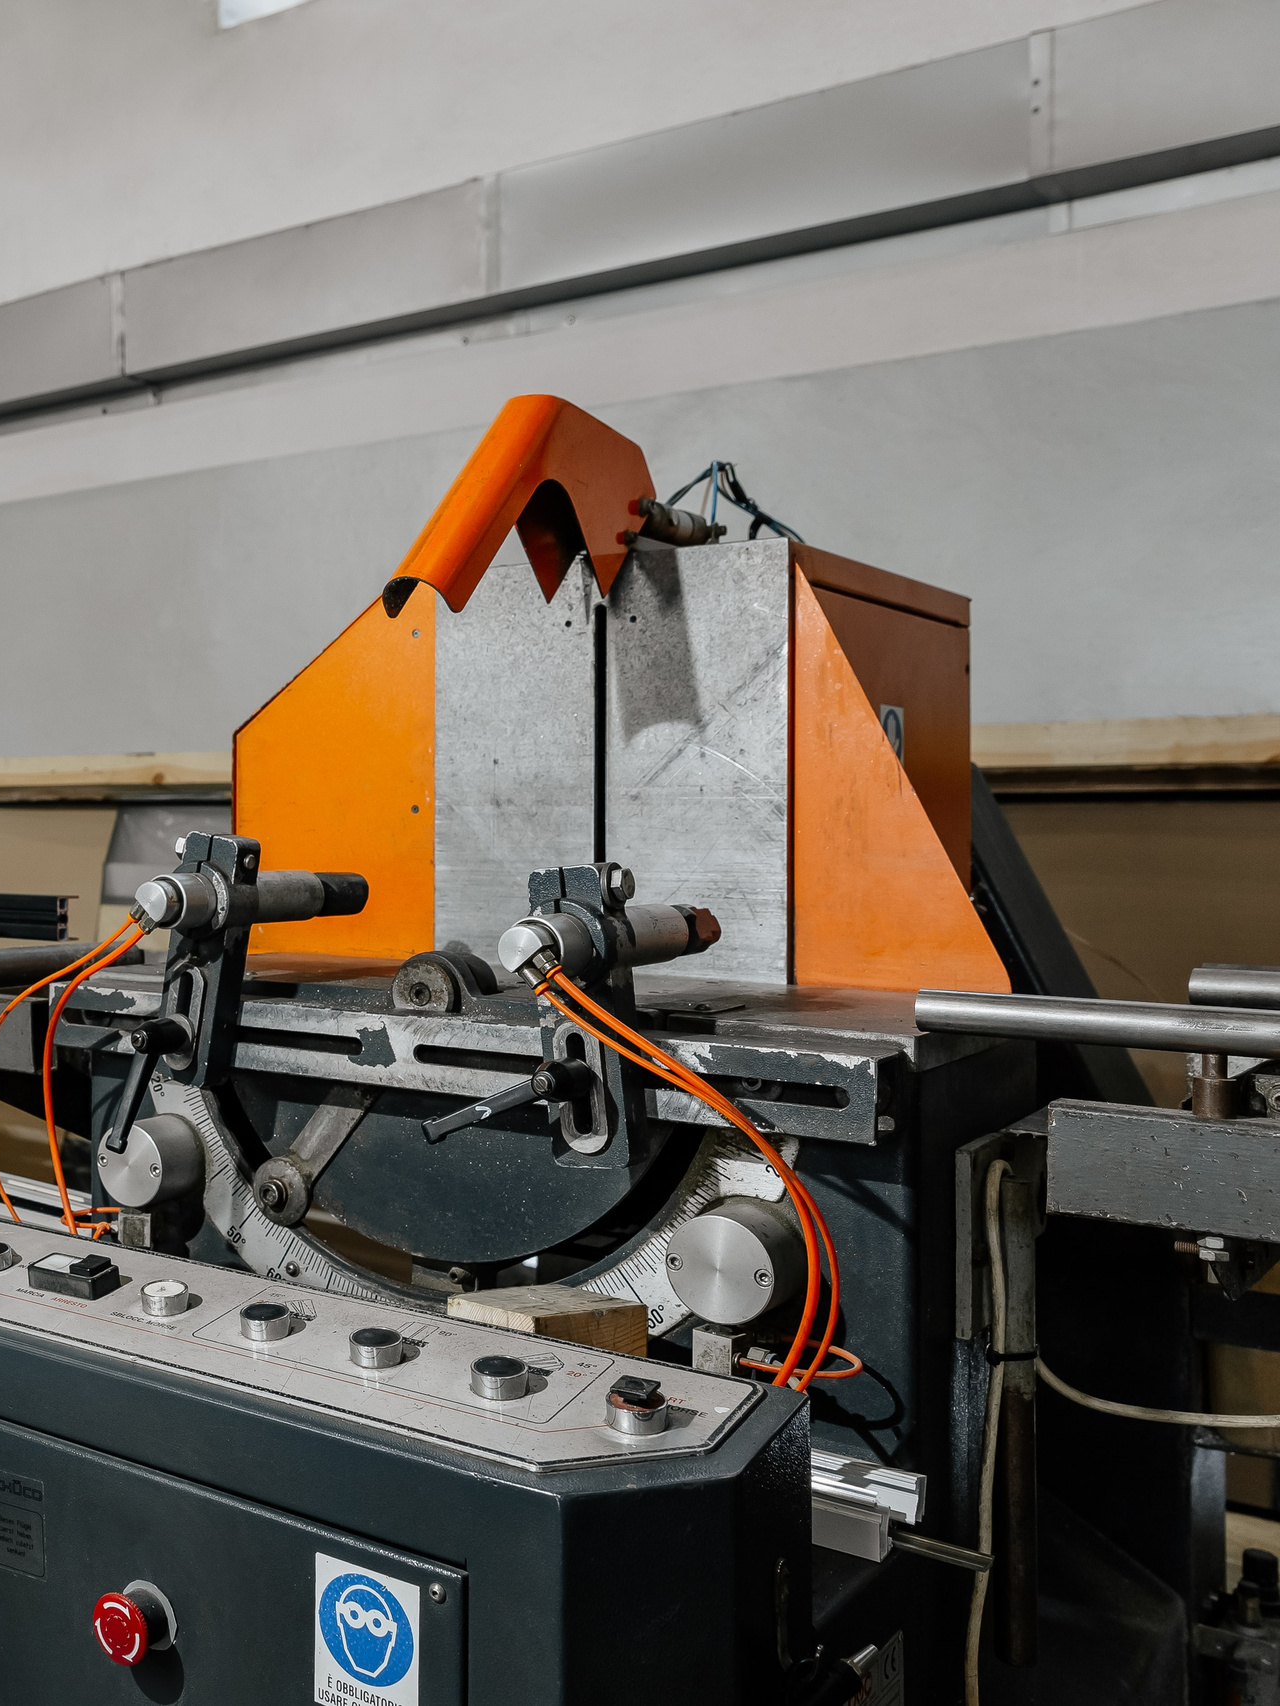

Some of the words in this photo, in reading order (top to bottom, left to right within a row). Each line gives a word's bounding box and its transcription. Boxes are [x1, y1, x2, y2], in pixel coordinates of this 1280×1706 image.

[226, 1225, 246, 1244] 50°
[16, 1287, 45, 1298] MARCIA
[51, 1296, 88, 1309] ARRESTO
[145, 1320, 178, 1331] MORSE
[666, 1404, 709, 1419] ORSE
[318, 1687, 348, 1706] USARE
[327, 1673, 333, 1689] È
[336, 1679, 404, 1706] OBBLIGATO
